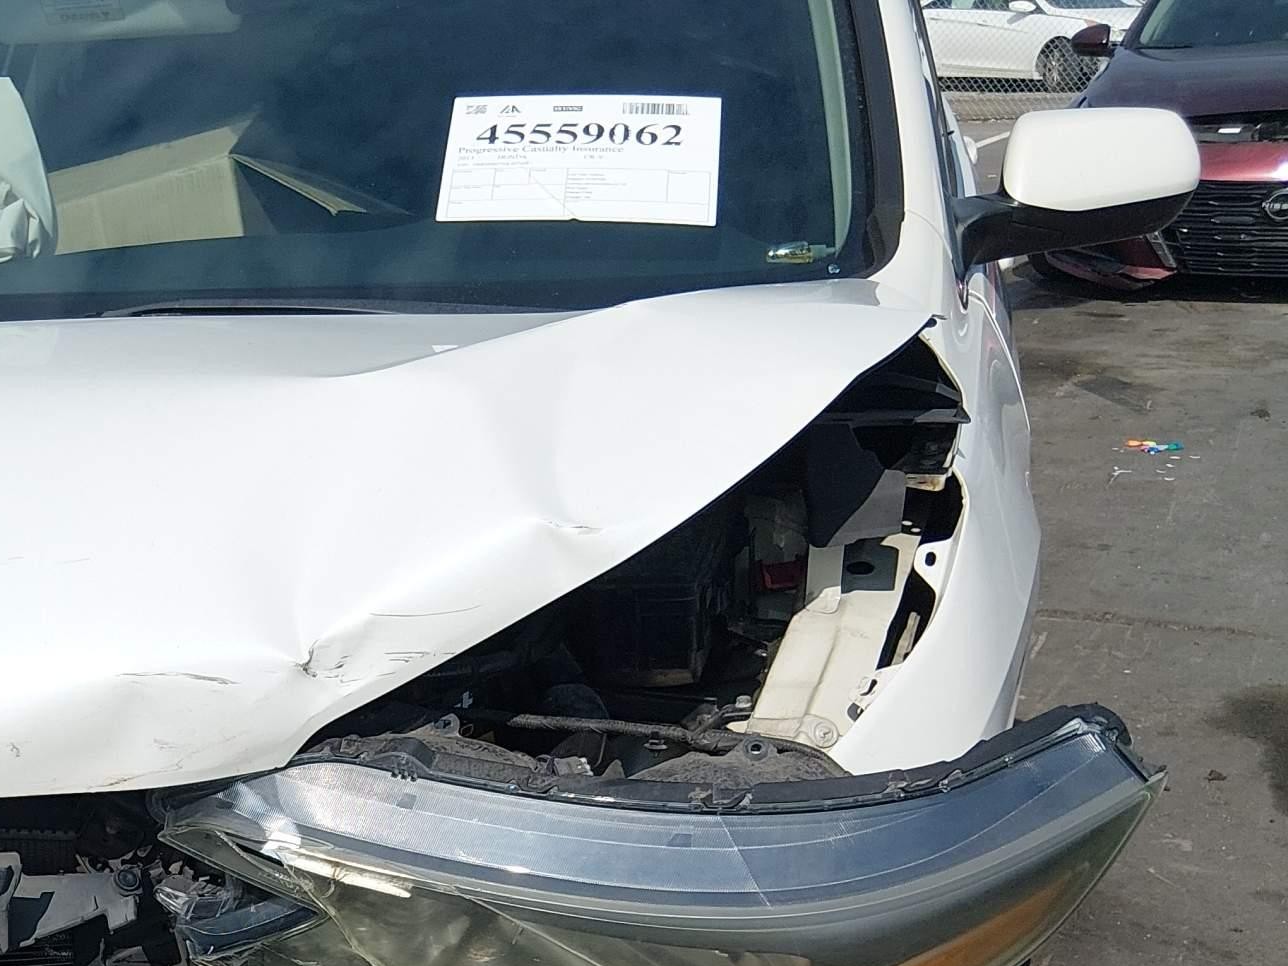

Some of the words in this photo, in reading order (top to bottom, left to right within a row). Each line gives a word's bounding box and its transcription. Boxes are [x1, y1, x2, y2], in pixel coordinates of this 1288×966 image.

[476, 122, 683, 146] 45559062
[458, 146, 520, 154] Progressive
[522, 145, 568, 154] Casualty
[572, 145, 625, 153] Insurance
